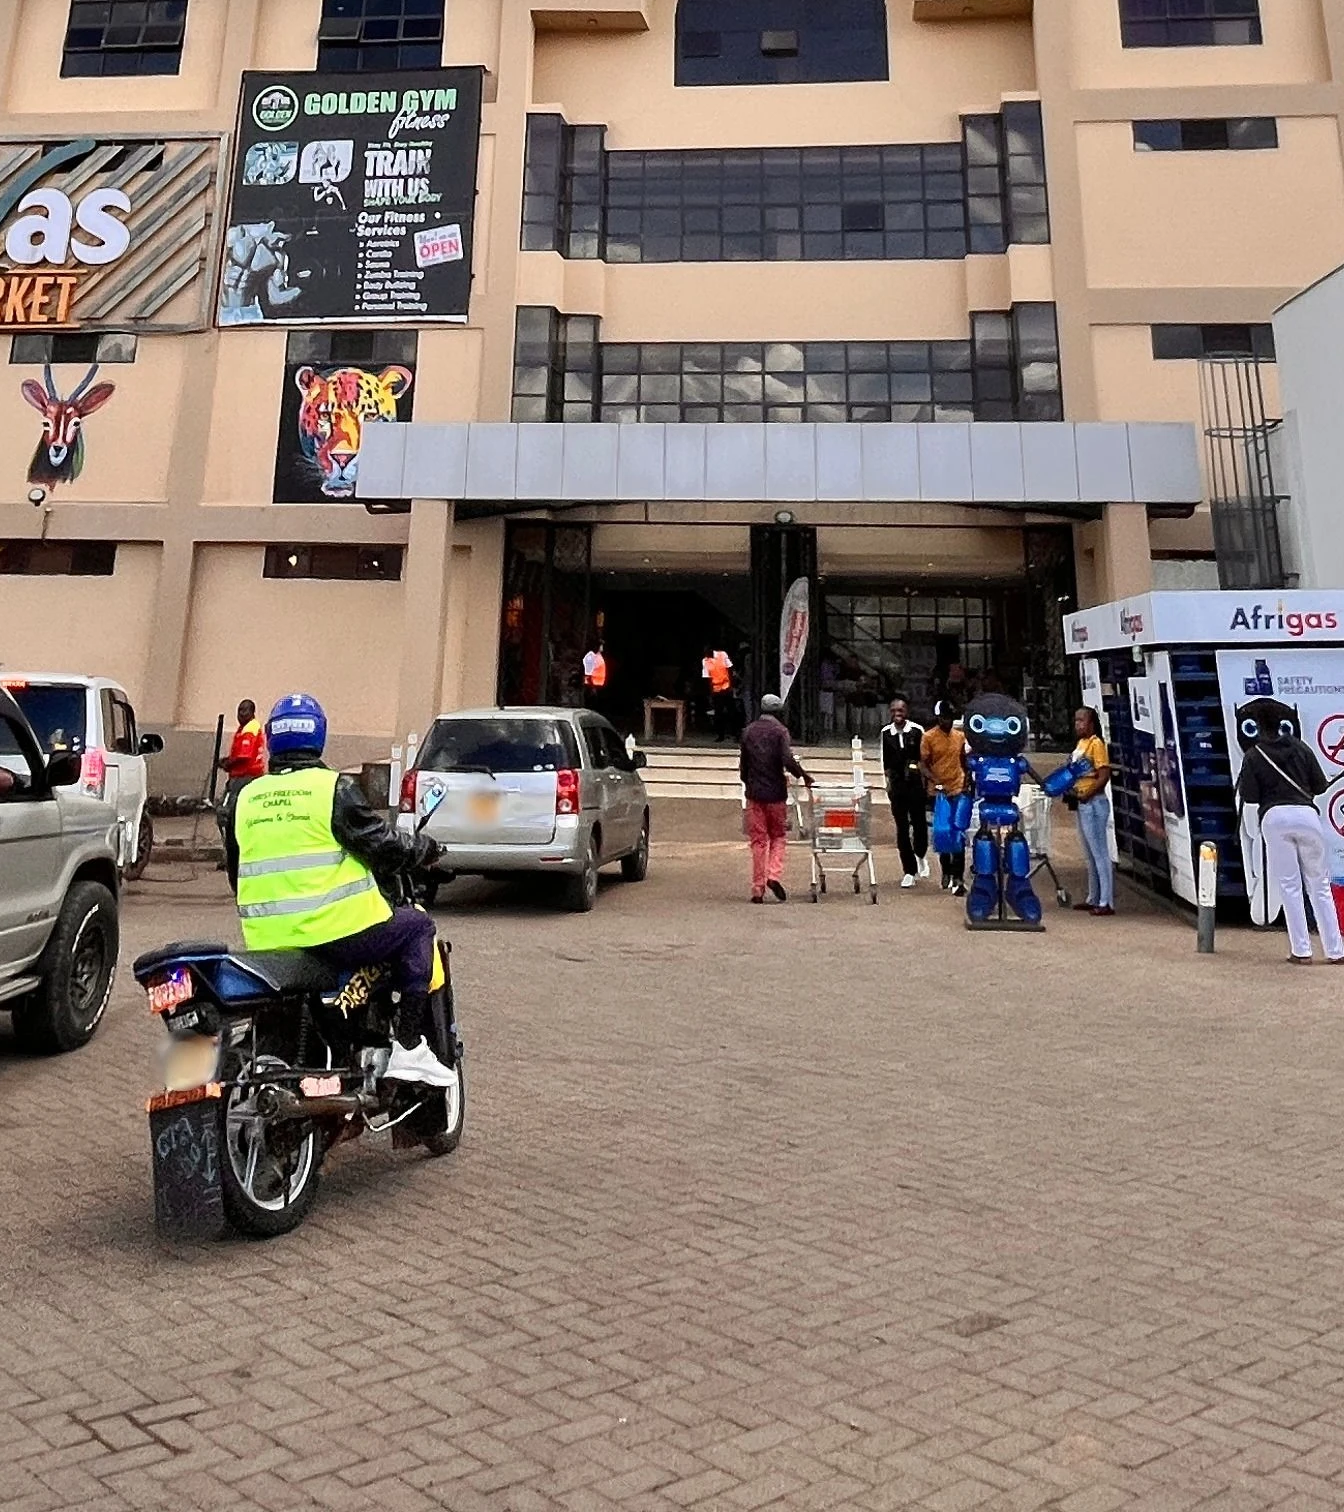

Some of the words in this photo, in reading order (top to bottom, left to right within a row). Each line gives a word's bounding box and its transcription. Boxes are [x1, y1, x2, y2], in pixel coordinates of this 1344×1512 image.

[304, 91, 397, 116] GOLDEN
[402, 88, 457, 113] GYM
[388, 108, 451, 139] fitness
[364, 149, 432, 177] TRAIN
[364, 178, 405, 198] WITH
[407, 177, 430, 197] US
[417, 192, 443, 204] BODY
[357, 211, 382, 224] Our
[383, 210, 426, 223] Fitness
[356, 224, 407, 237] Services
[419, 239, 459, 258] OPEN
[1230, 600, 1338, 636] Afrigas
[1277, 676, 1312, 685] SAFETY
